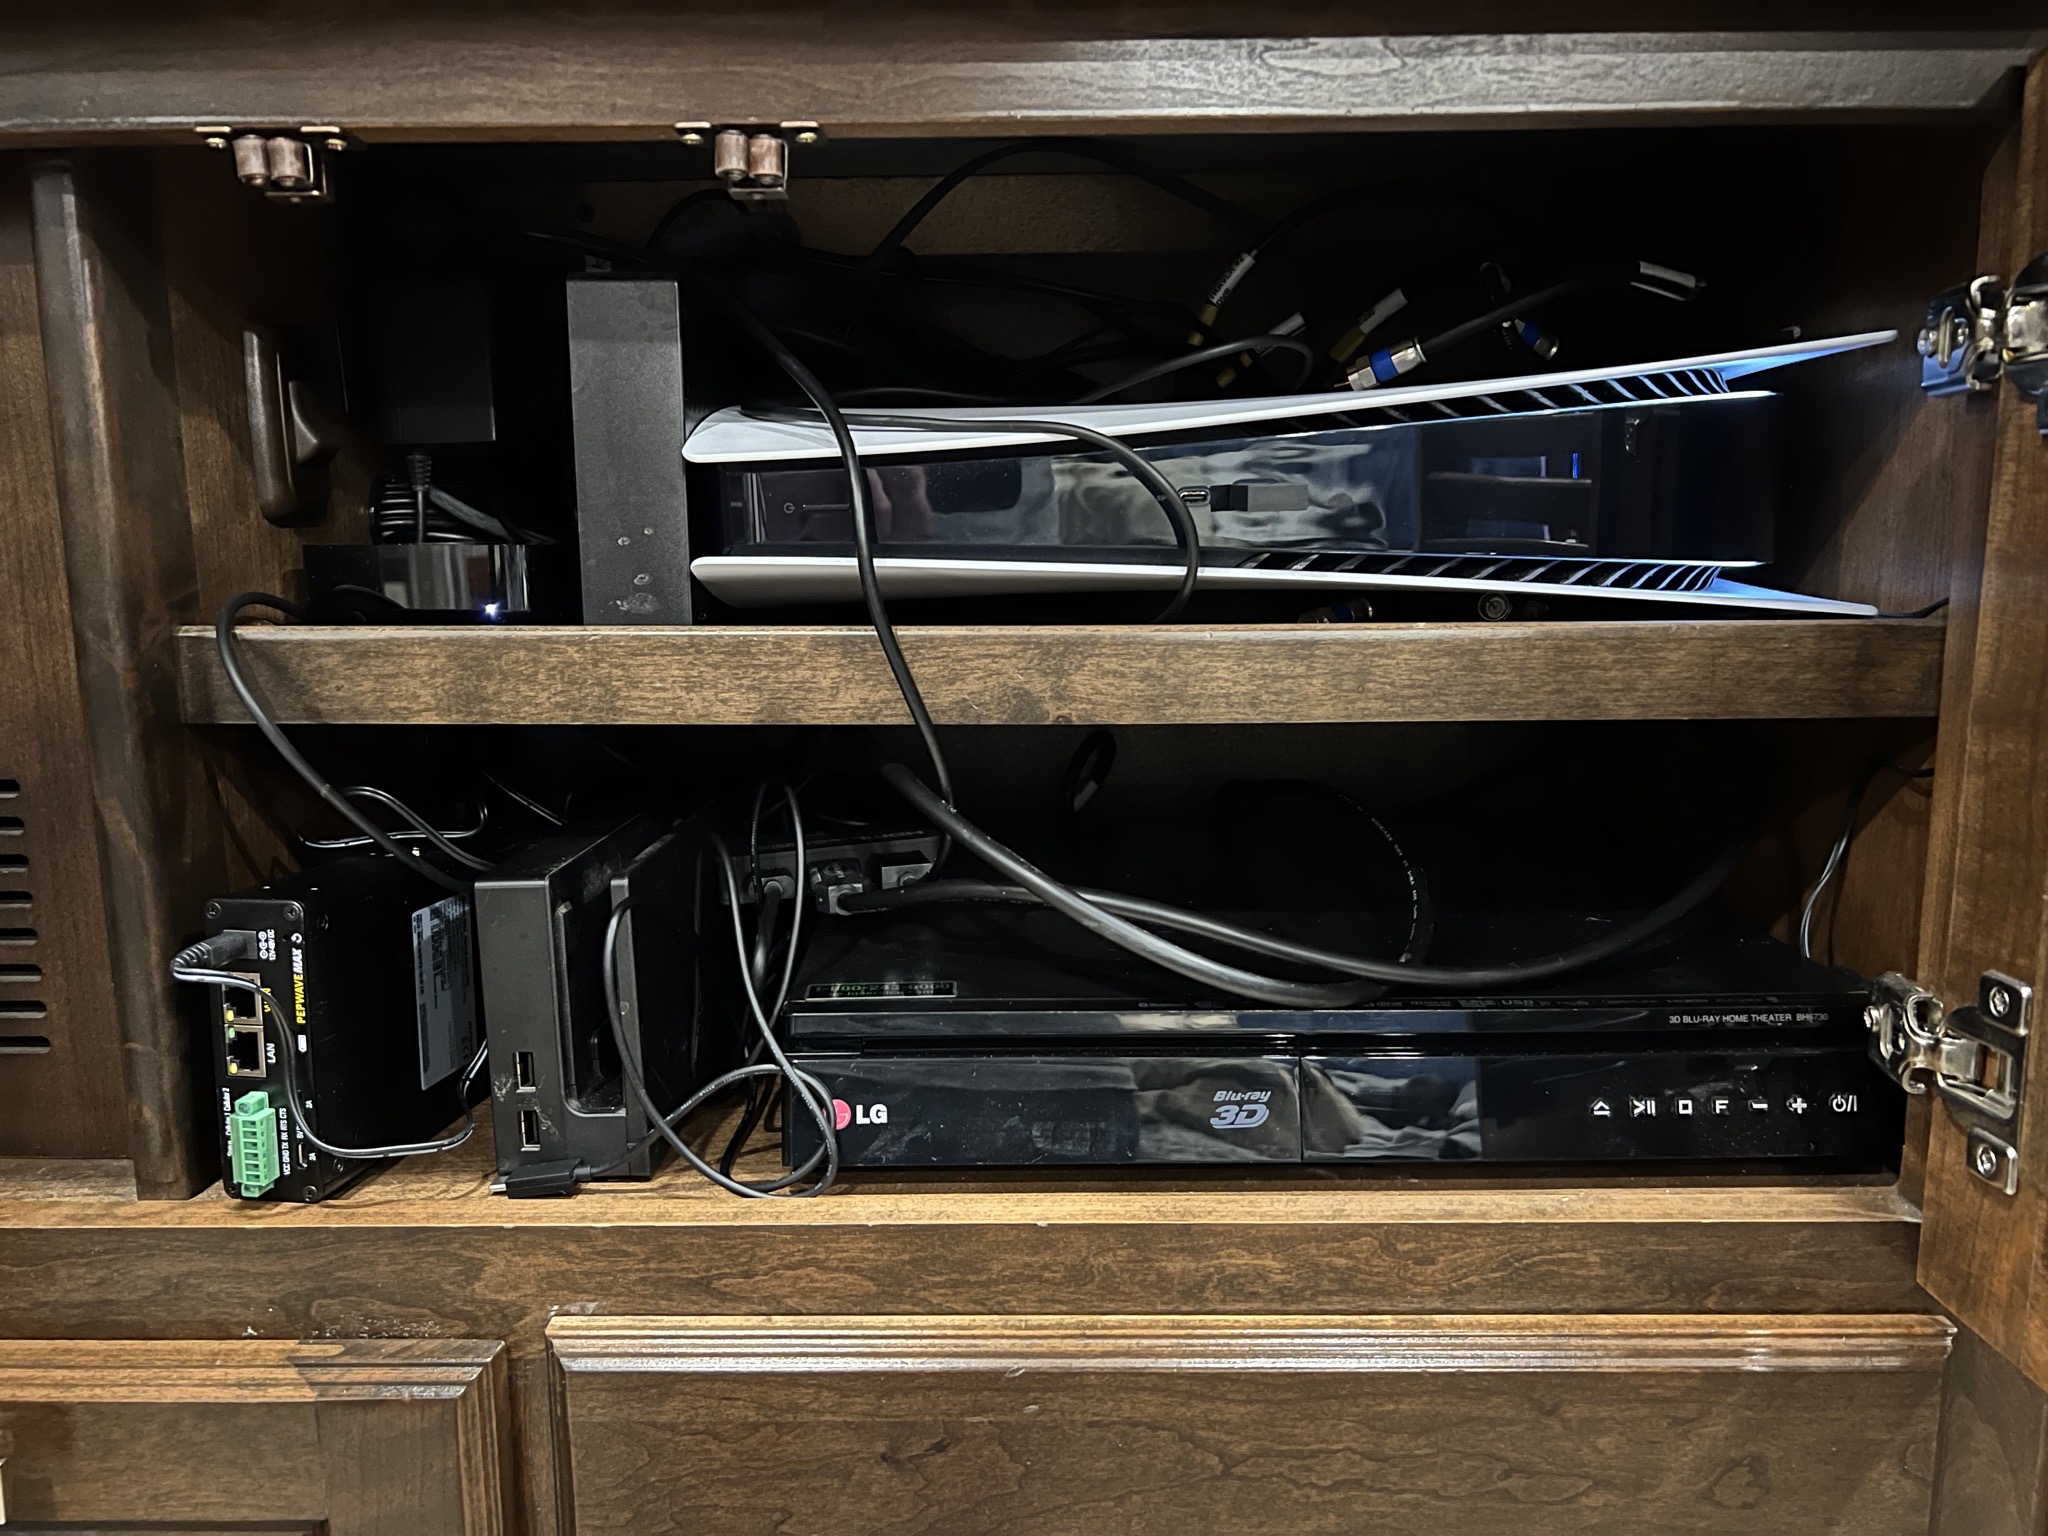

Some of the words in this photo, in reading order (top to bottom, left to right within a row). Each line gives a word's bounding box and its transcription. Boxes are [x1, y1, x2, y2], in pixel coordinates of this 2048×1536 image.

[291, 947, 303, 974] MAX
[263, 987, 272, 1013] WN
[293, 974, 306, 1024] PEPWAVE
[1668, 1015, 1681, 1024] 3D
[1682, 1014, 1721, 1024] BLU-RAY
[1722, 1014, 1749, 1023] HOME
[1751, 1013, 1792, 1022] THEATER
[266, 1043, 276, 1064] LAN
[279, 1107, 287, 1119] CTS
[855, 1103, 888, 1125] LG
[1209, 1103, 1270, 1129] 3D
[281, 1141, 289, 1150] TX
[308, 1152, 316, 1161] 2A
[283, 1163, 291, 1176] VCC
